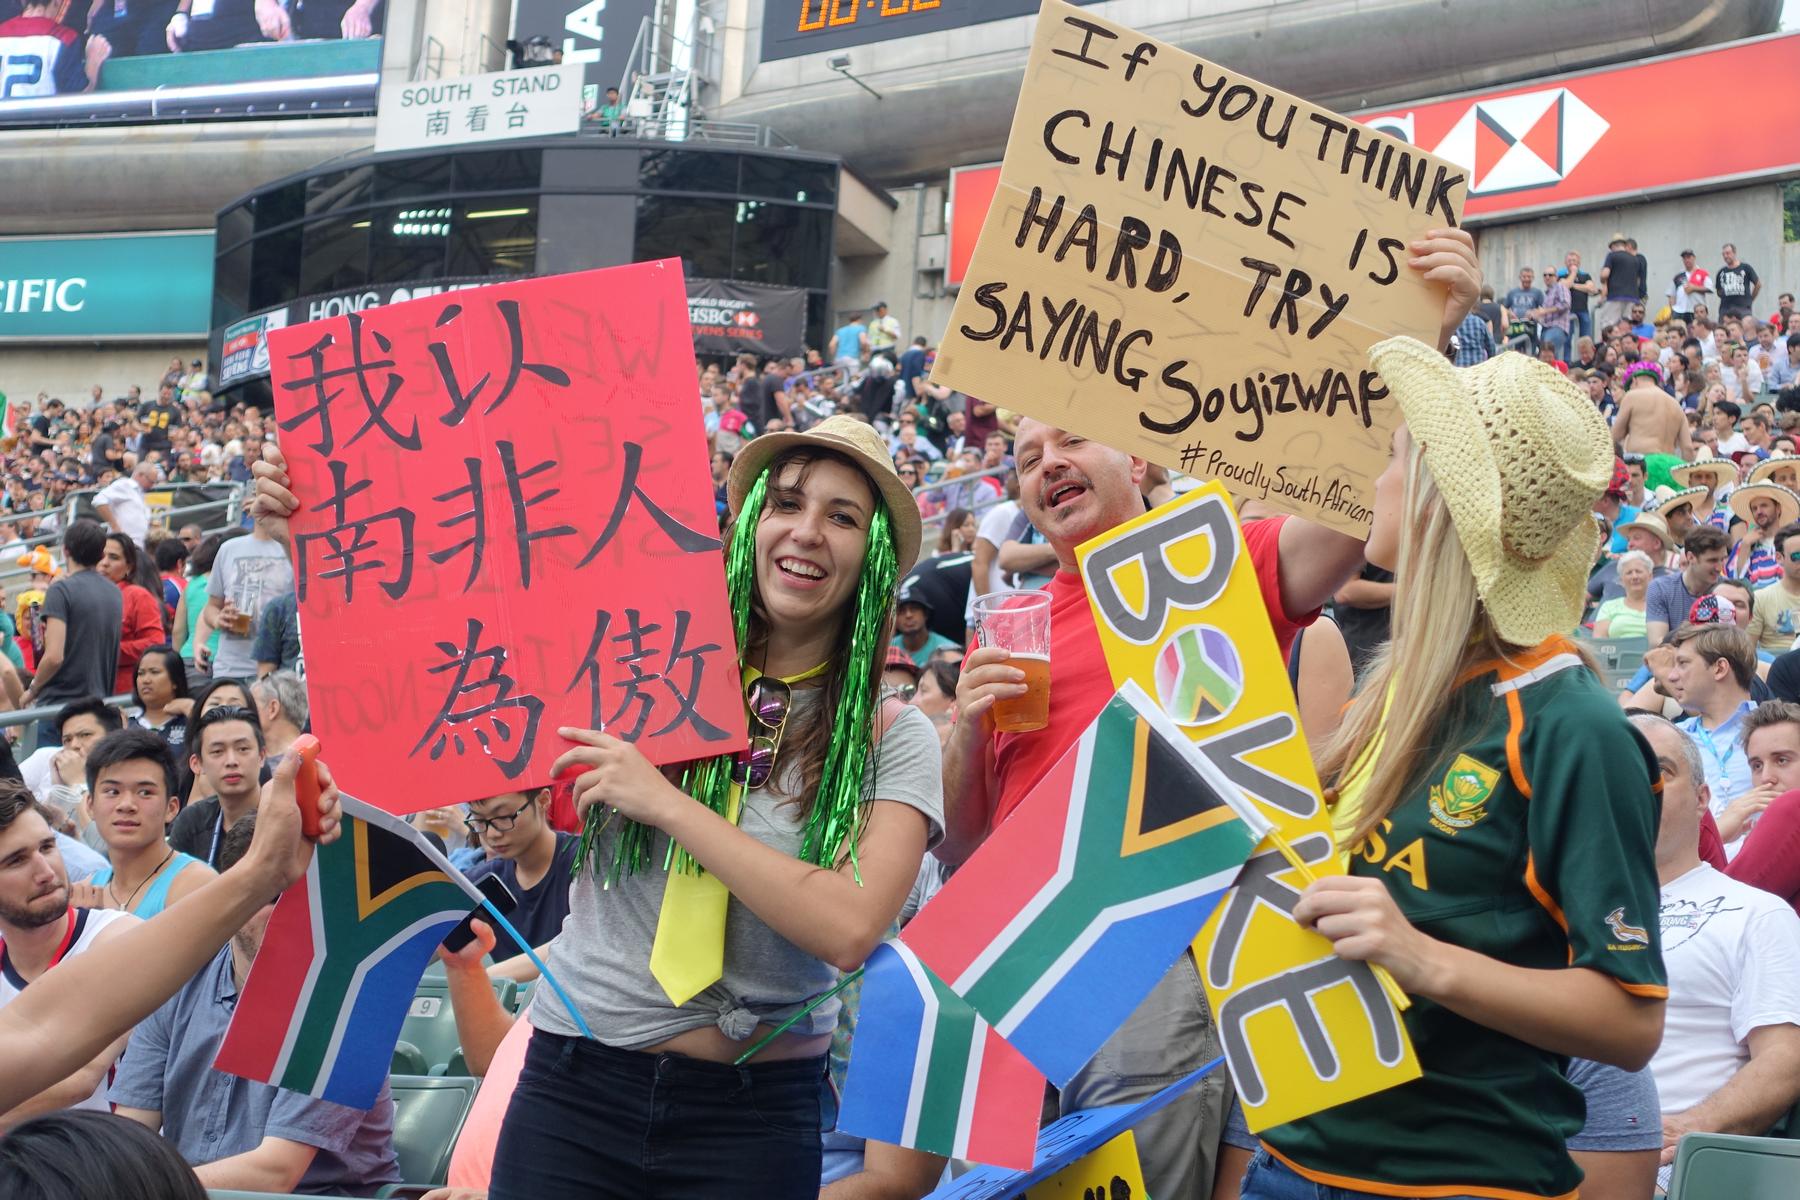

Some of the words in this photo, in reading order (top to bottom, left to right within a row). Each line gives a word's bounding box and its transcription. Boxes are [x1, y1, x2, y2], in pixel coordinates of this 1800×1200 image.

[401, 83, 472, 107] SOUTH
[491, 73, 561, 97] STAND
[426, 102, 529, 137] 南看台
[1052, 16, 1158, 82] If
[1310, 112, 1465, 227] THINK
[1044, 109, 1306, 249] CHINESE
[1348, 229, 1405, 286] IS
[0, 277, 88, 313] IFIC
[1015, 186, 1190, 304] HARD,
[1241, 256, 1350, 340] TRY
[960, 281, 1153, 393] SAYING
[295, 441, 723, 604] 南非人
[420, 999, 431, 1015] 9
